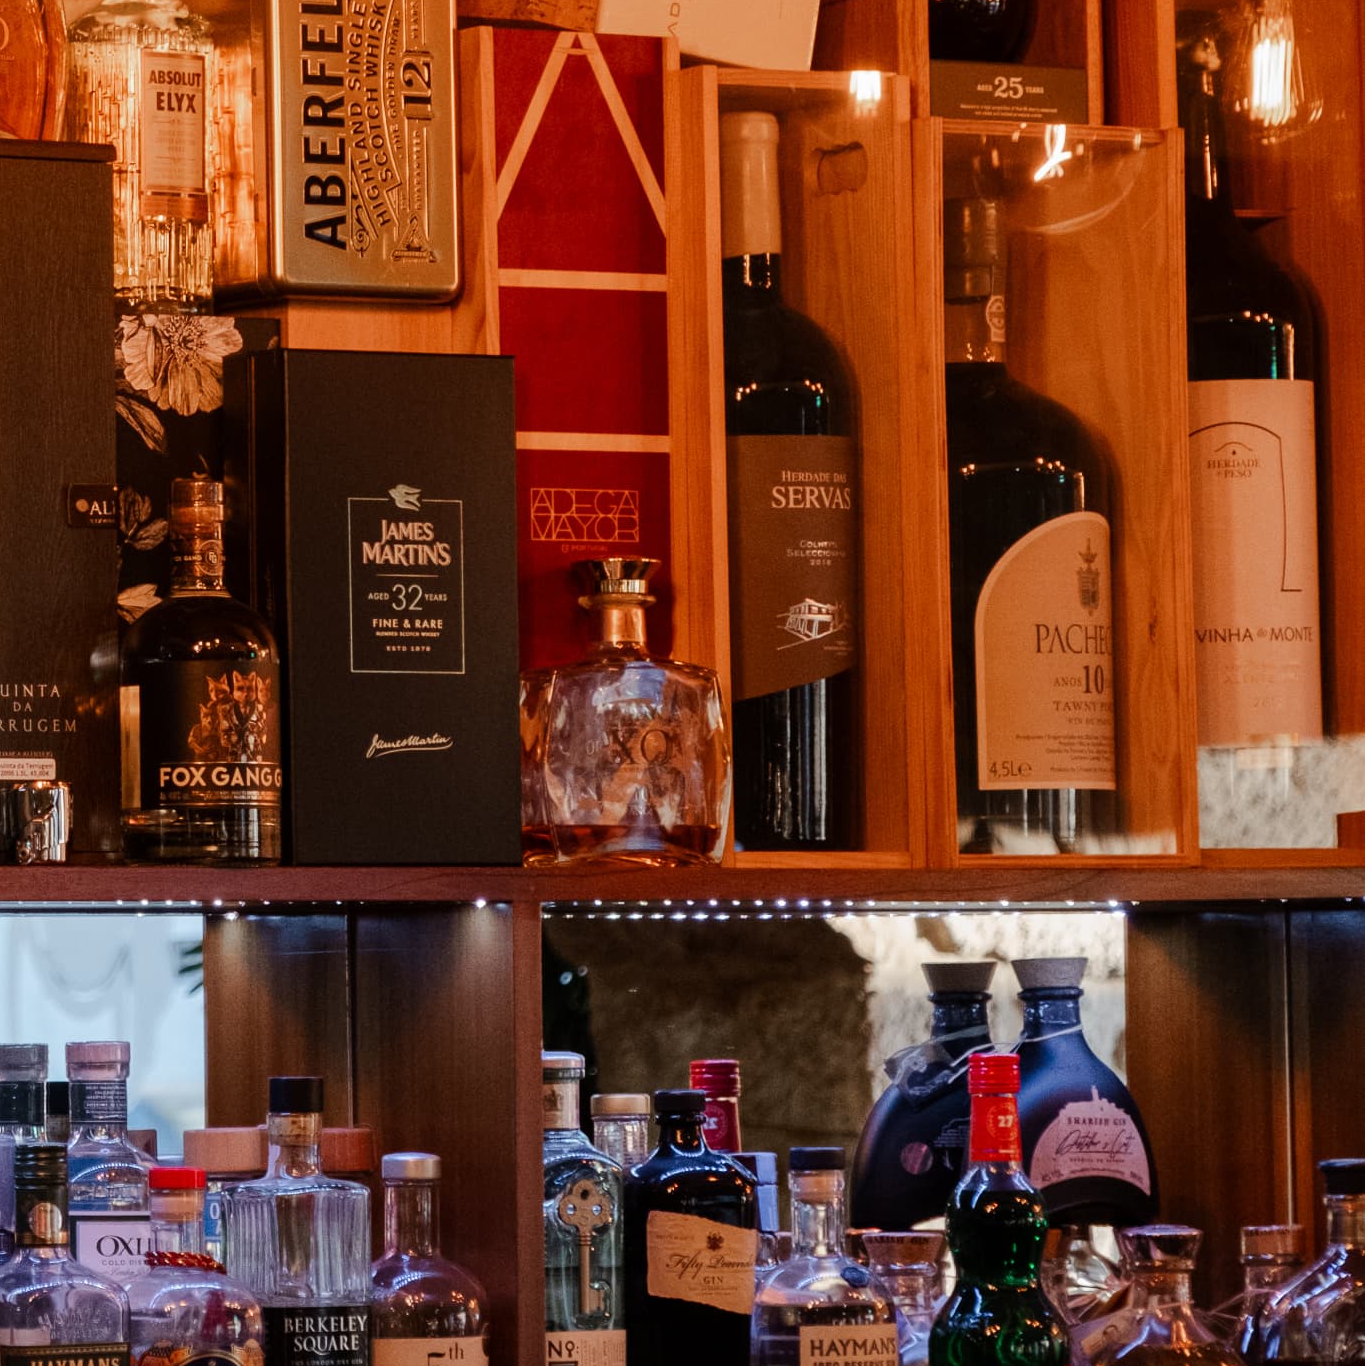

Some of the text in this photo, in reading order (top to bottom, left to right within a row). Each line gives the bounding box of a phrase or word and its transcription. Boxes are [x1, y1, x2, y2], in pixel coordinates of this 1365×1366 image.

[347, 2, 367, 89] SINGLE
[149, 70, 201, 85] ABSOLUT
[401, 54, 432, 119] 12
[994, 76, 1024, 99] 25
[156, 91, 196, 114] ELYX
[365, 85, 394, 183] SCOTCH
[348, 101, 391, 227] HIGHLAND
[1208, 459, 1260, 469] HERDADE
[782, 471, 830, 483] HERDADE
[772, 486, 851, 510] SERVAS
[381, 520, 434, 543] JAMES
[362, 541, 451, 566] MARTIN'S
[368, 584, 447, 611] AGED 32 YEARS
[372, 619, 443, 629] FINE & RARE
[1195, 627, 1313, 643] VINHA MONTE
[1053, 665, 1105, 695] ANOS 10
[14, 702, 32, 712] DA
[160, 766, 273, 787] FOX GANG
[998, 1116, 1013, 1127] 27
[666, 1251, 705, 1281] Fifty
[703, 1276, 724, 1285] GIN
[284, 1315, 368, 1334] BERKELEY
[293, 1334, 360, 1356] SQUARE
[810, 1338, 896, 1357] HAYMAN'S
